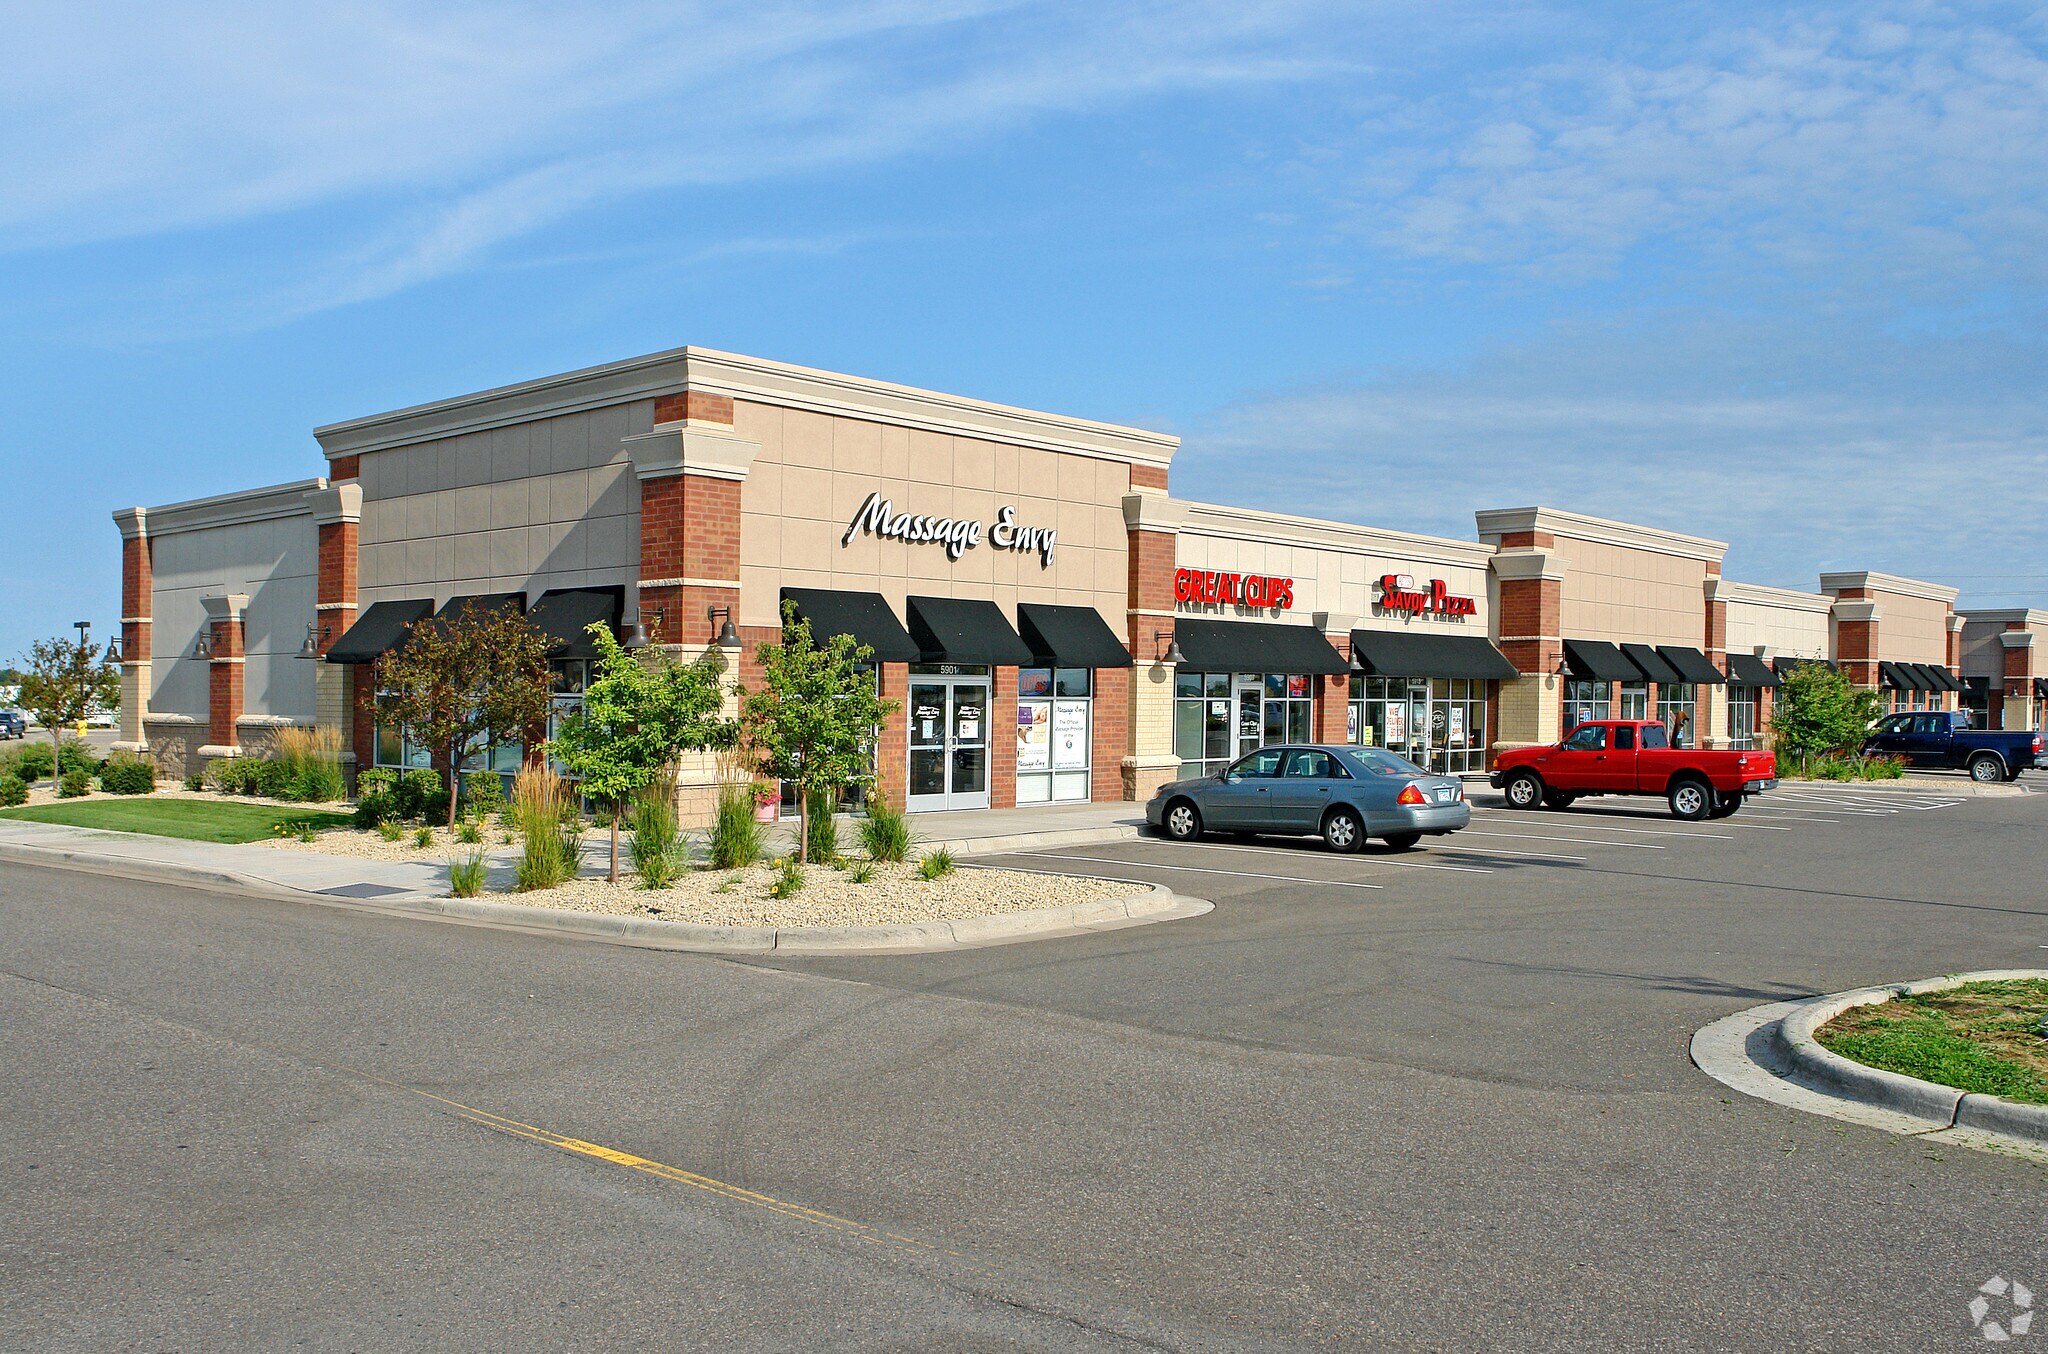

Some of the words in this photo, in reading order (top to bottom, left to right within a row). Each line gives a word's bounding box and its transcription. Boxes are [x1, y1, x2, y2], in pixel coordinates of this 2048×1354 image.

[842, 491, 982, 561] Massage
[989, 505, 1058, 569] Envy
[1174, 567, 1242, 604] GREAT
[1245, 574, 1294, 610] CLIPS
[1381, 574, 1431, 617] SAVOY
[1431, 579, 1477, 615] PIZZA
[940, 665, 957, 674] 5901
[1389, 707, 1399, 716] WE
